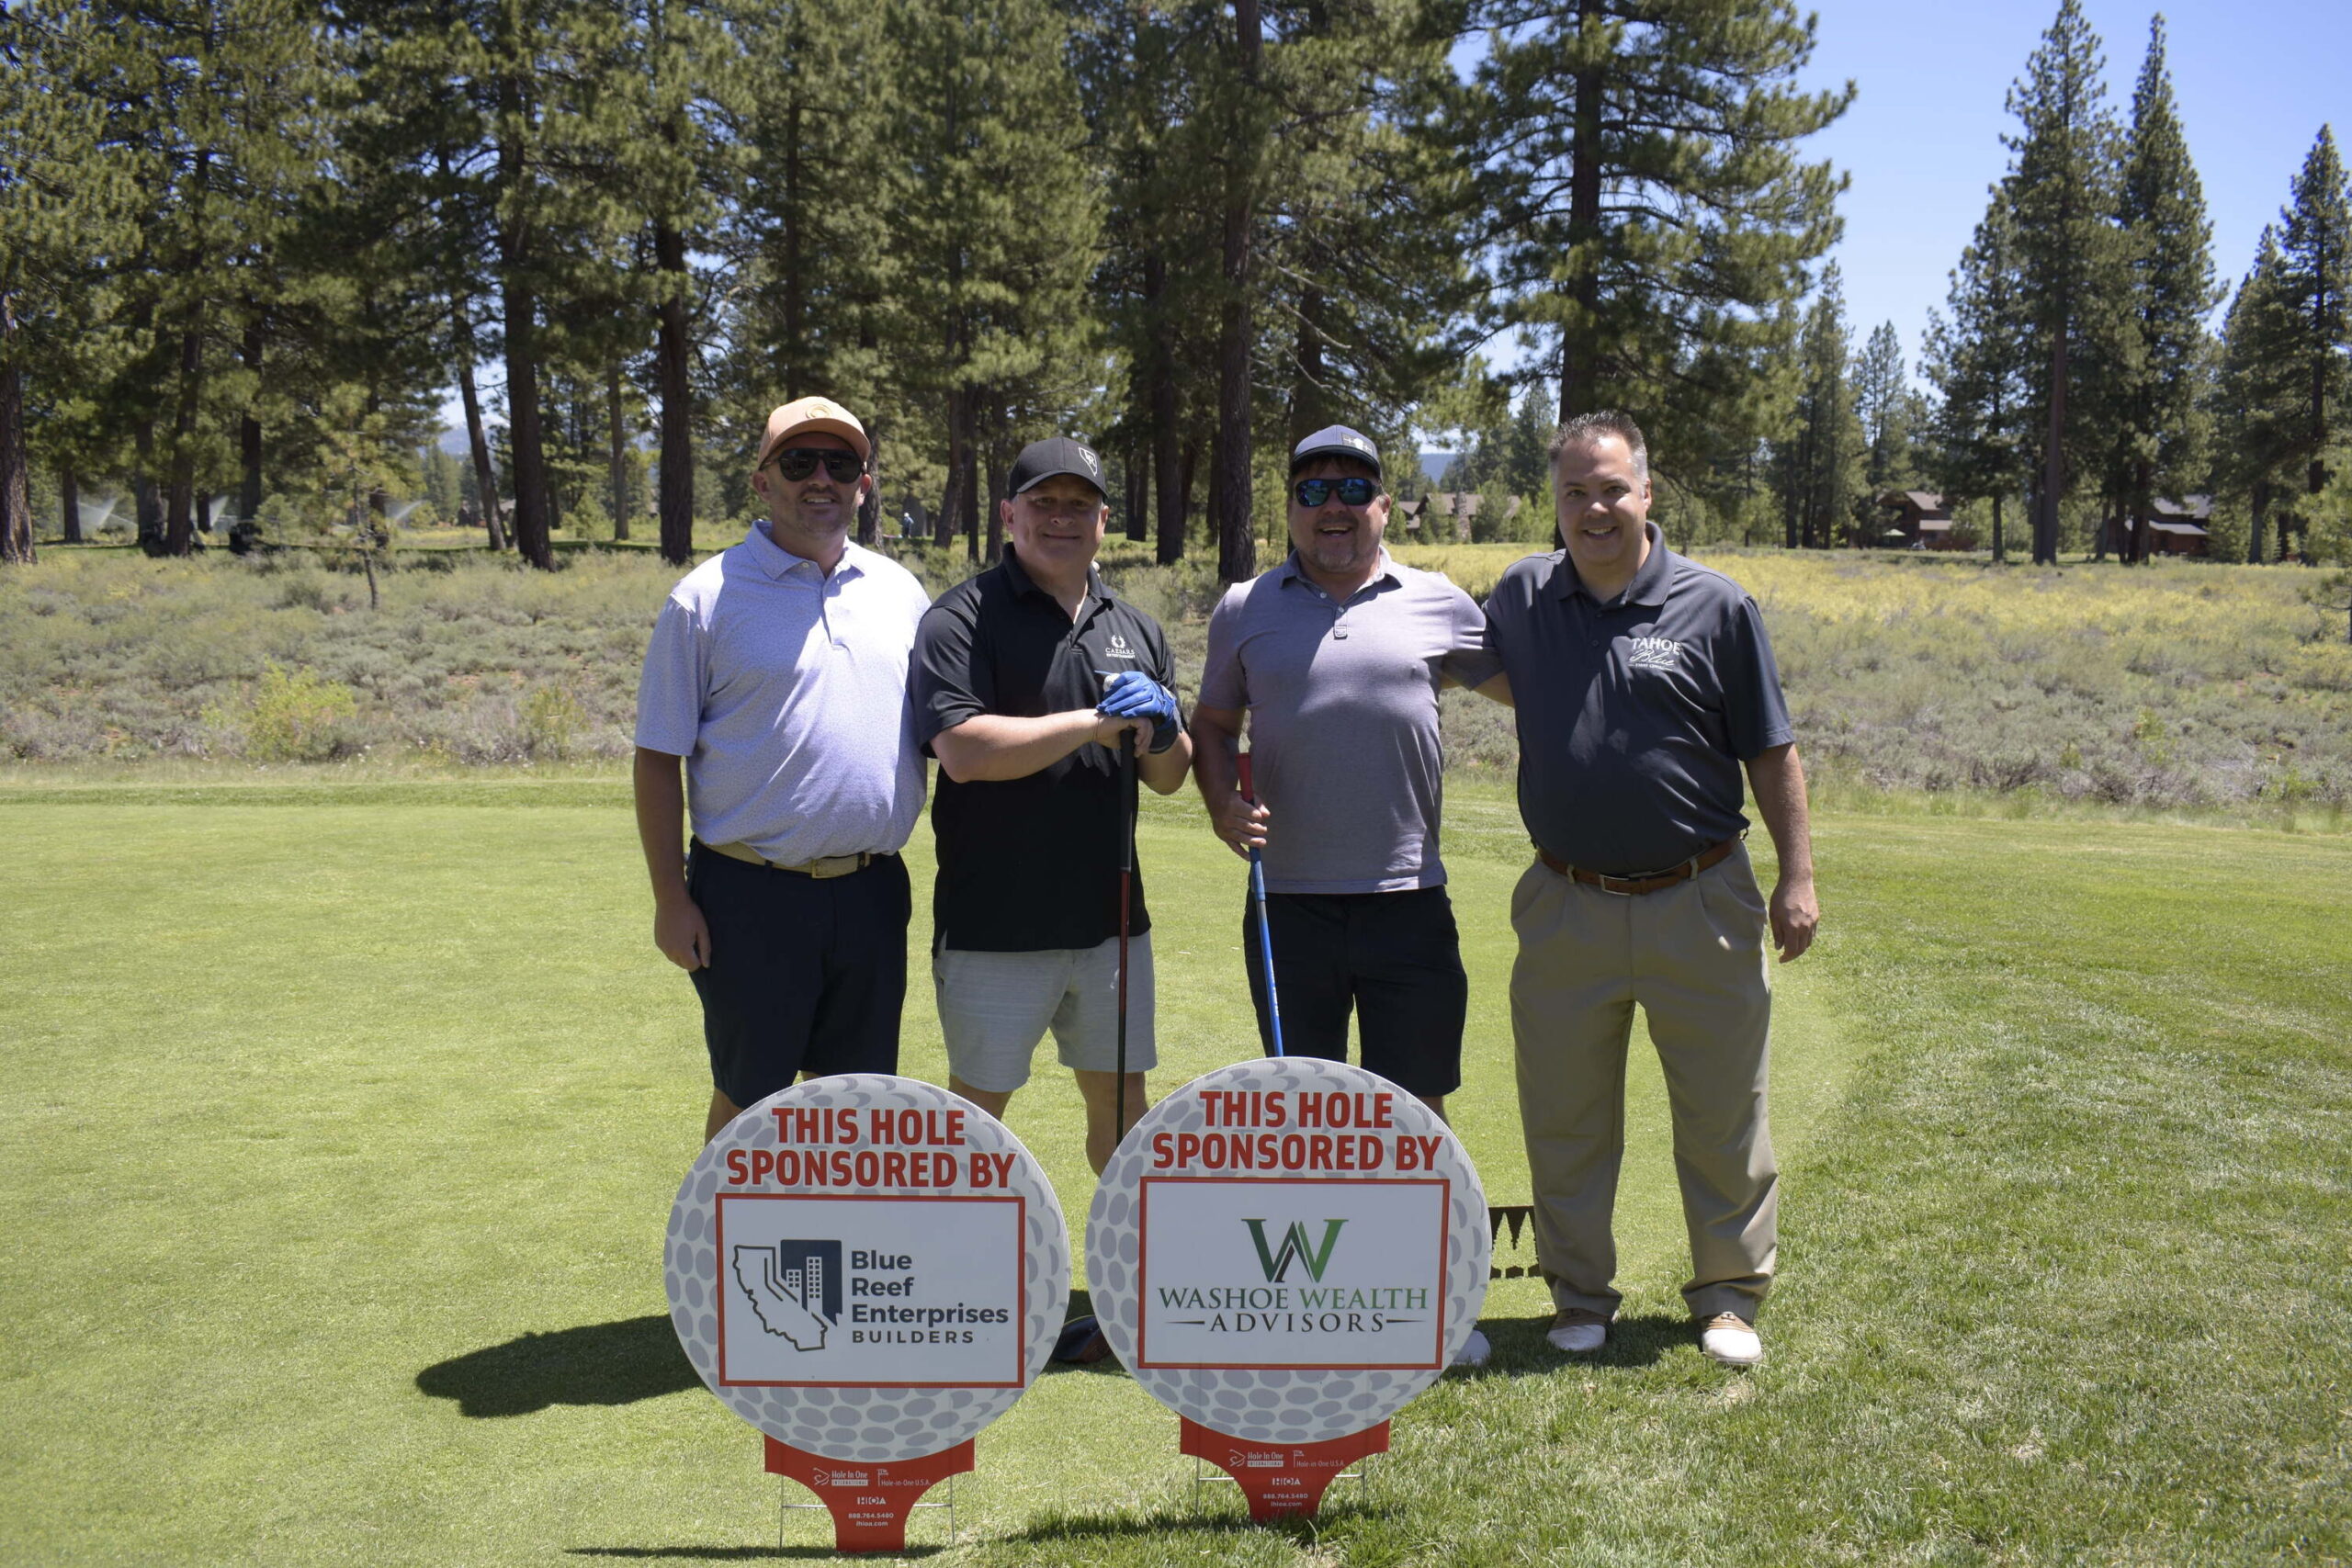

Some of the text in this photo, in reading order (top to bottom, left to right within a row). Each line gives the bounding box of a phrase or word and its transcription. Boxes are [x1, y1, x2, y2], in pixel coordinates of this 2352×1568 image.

[1632, 637, 1680, 655] TAHOE
[1629, 649, 1675, 666] Blue
[1199, 1091, 1393, 1128] THIS HOLE
[772, 1108, 965, 1145] THIS HOLE
[1152, 1133, 1442, 1170] SPONSORED BY
[727, 1150, 1016, 1188] SPONSORED BY
[851, 1250, 912, 1269] Blue
[852, 1277, 914, 1296] Reef
[1158, 1288, 1428, 1310] WASHOE WEALTH
[852, 1303, 1009, 1327] Enterprises
[1209, 1313, 1384, 1332] ADVISORS
[852, 1330, 974, 1344] BUILDERS
[1248, 1451, 1262, 1460] Hole
